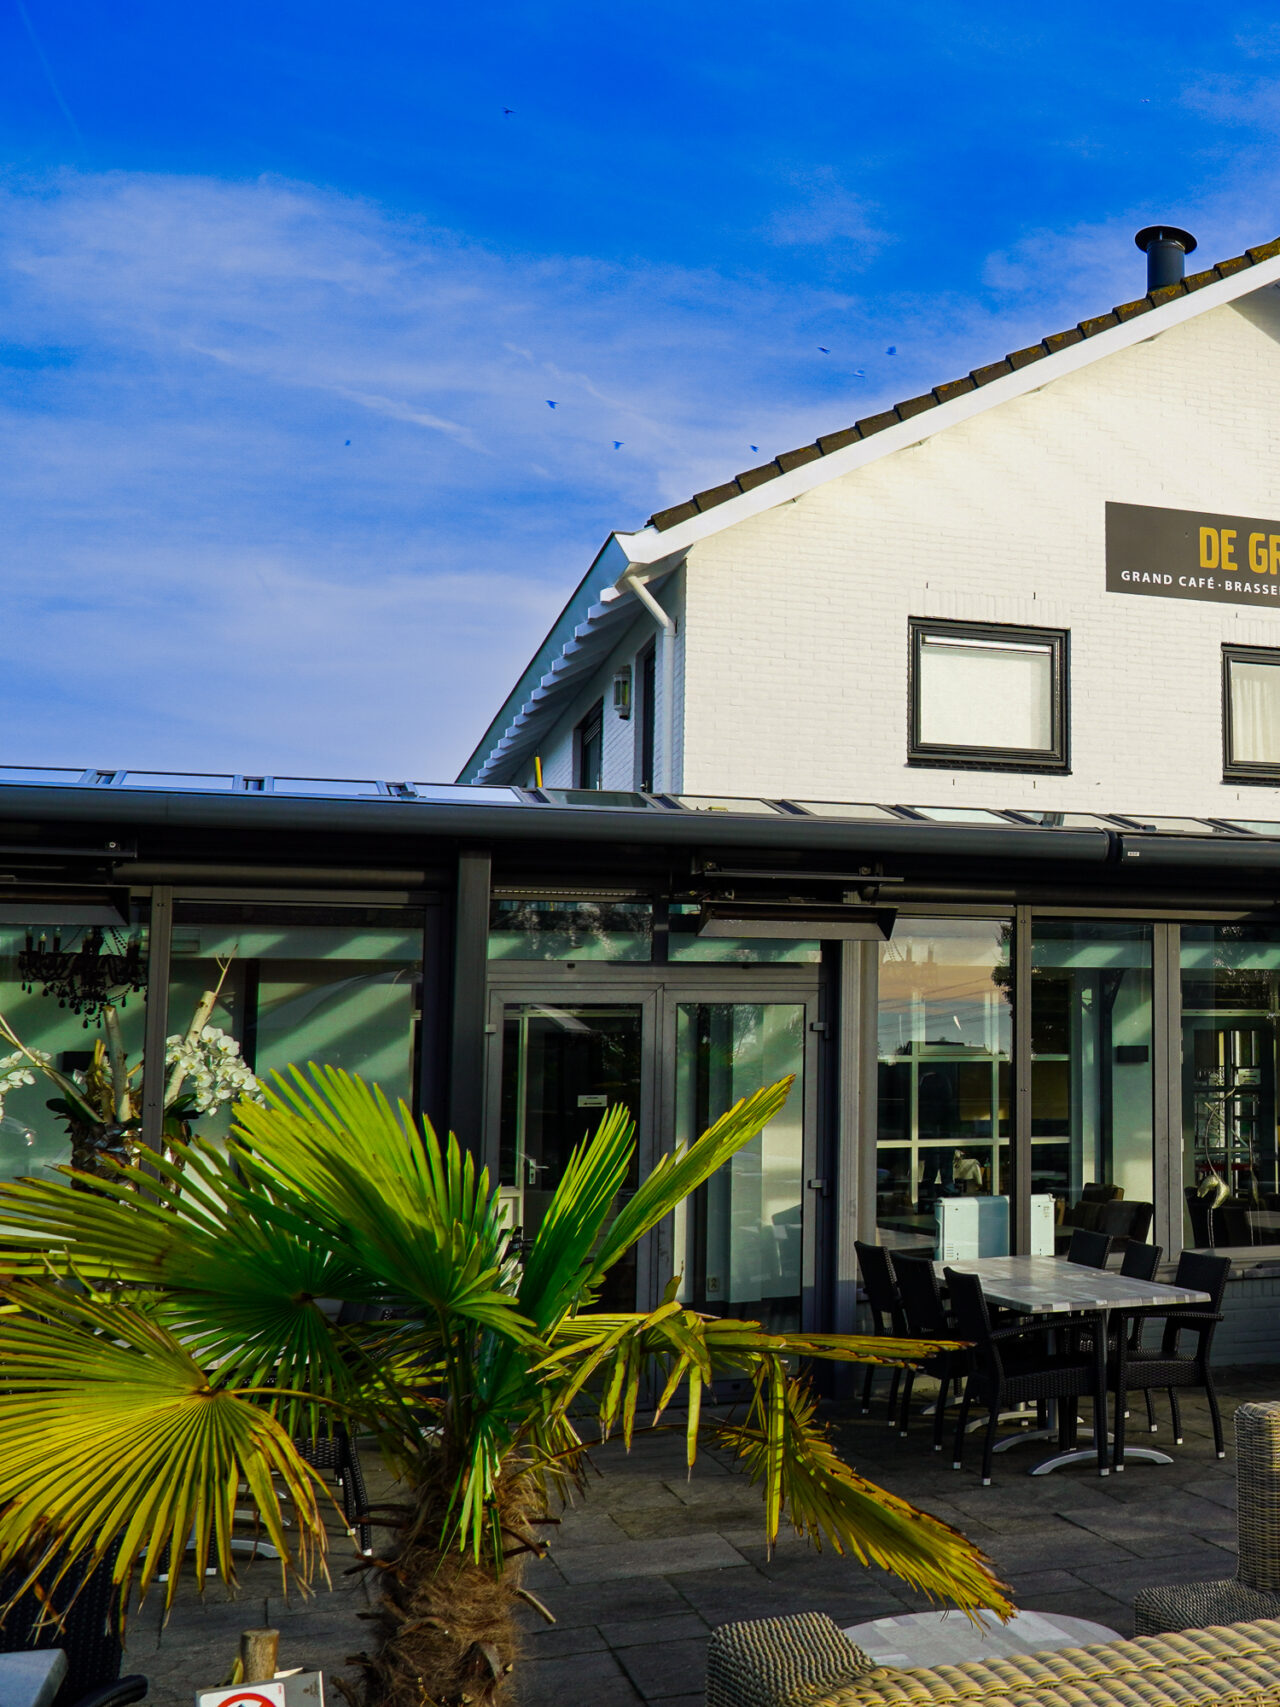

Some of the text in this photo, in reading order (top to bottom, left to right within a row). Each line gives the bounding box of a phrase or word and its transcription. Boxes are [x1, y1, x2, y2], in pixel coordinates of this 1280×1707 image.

[1200, 527, 1238, 570] DE
[1121, 571, 1172, 584] GRAND
[1179, 576, 1214, 589] CAFÉ
